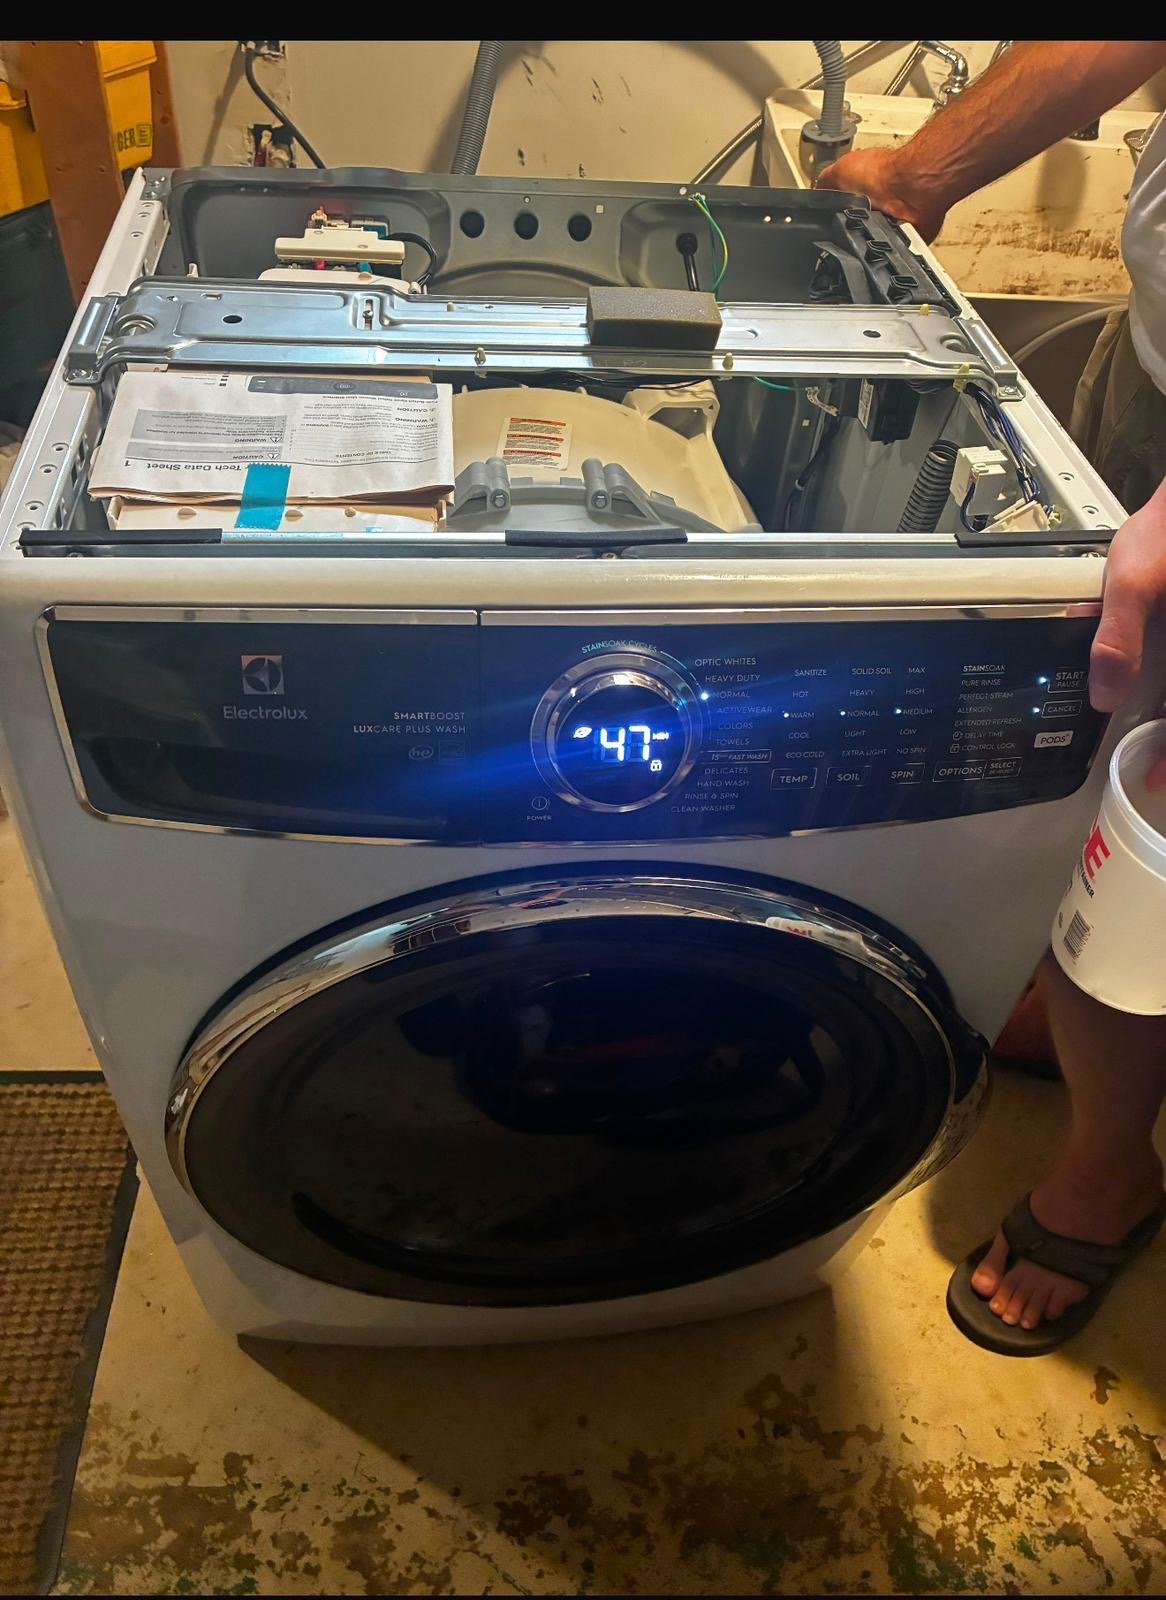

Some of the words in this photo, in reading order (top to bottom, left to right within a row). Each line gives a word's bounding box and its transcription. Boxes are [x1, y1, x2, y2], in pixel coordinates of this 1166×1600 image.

[146, 463, 181, 471] Sheet
[581, 640, 626, 654] STAINSOAK
[695, 658, 721, 667] OPTIC
[724, 657, 756, 666] WHITES
[852, 667, 875, 675] SOLID
[875, 667, 892, 675] SOIL
[962, 664, 1007, 672] STAINSOAK
[794, 669, 828, 677] SANITIZE
[1056, 671, 1084, 680] START
[737, 674, 760, 682] DUTY
[1057, 680, 1080, 688] PAUSE
[712, 691, 750, 699] NORMAL
[850, 689, 875, 697] HEAVY
[223, 705, 308, 720] Electrolux
[717, 706, 773, 714] ACTIVEWEAR
[1048, 705, 1077, 713] CANCEL
[394, 711, 465, 721] SMARTBOOST
[353, 725, 401, 733] LUXCARE
[406, 725, 431, 733] PLUS
[435, 725, 466, 733] WASH
[718, 722, 753, 730] COLORS
[900, 728, 917, 736] LOW
[600, 725, 651, 762] 47
[716, 738, 750, 746] TOWELS
[990, 761, 1017, 769] SELECT
[704, 767, 748, 775] DELICATES
[891, 771, 914, 779] SPIN
[938, 766, 984, 777] OPTIONS
[780, 775, 808, 783] TEMP
[837, 774, 860, 782] SOIL
